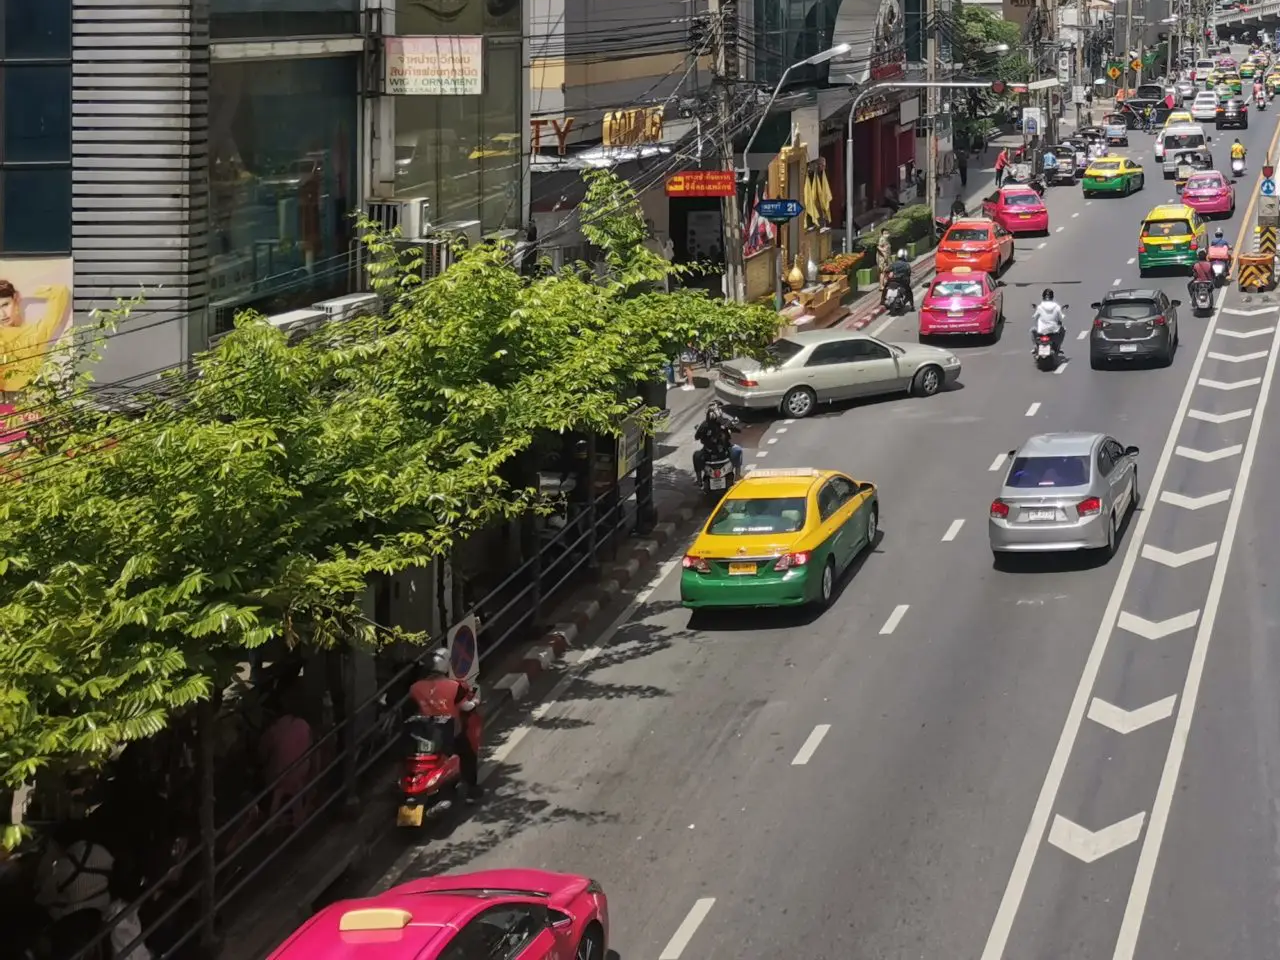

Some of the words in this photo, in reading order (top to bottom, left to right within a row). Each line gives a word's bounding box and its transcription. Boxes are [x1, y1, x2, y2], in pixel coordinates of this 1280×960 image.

[389, 77, 409, 87] WIG
[421, 77, 479, 87] ORNAMENT
[786, 202, 797, 212] 21
